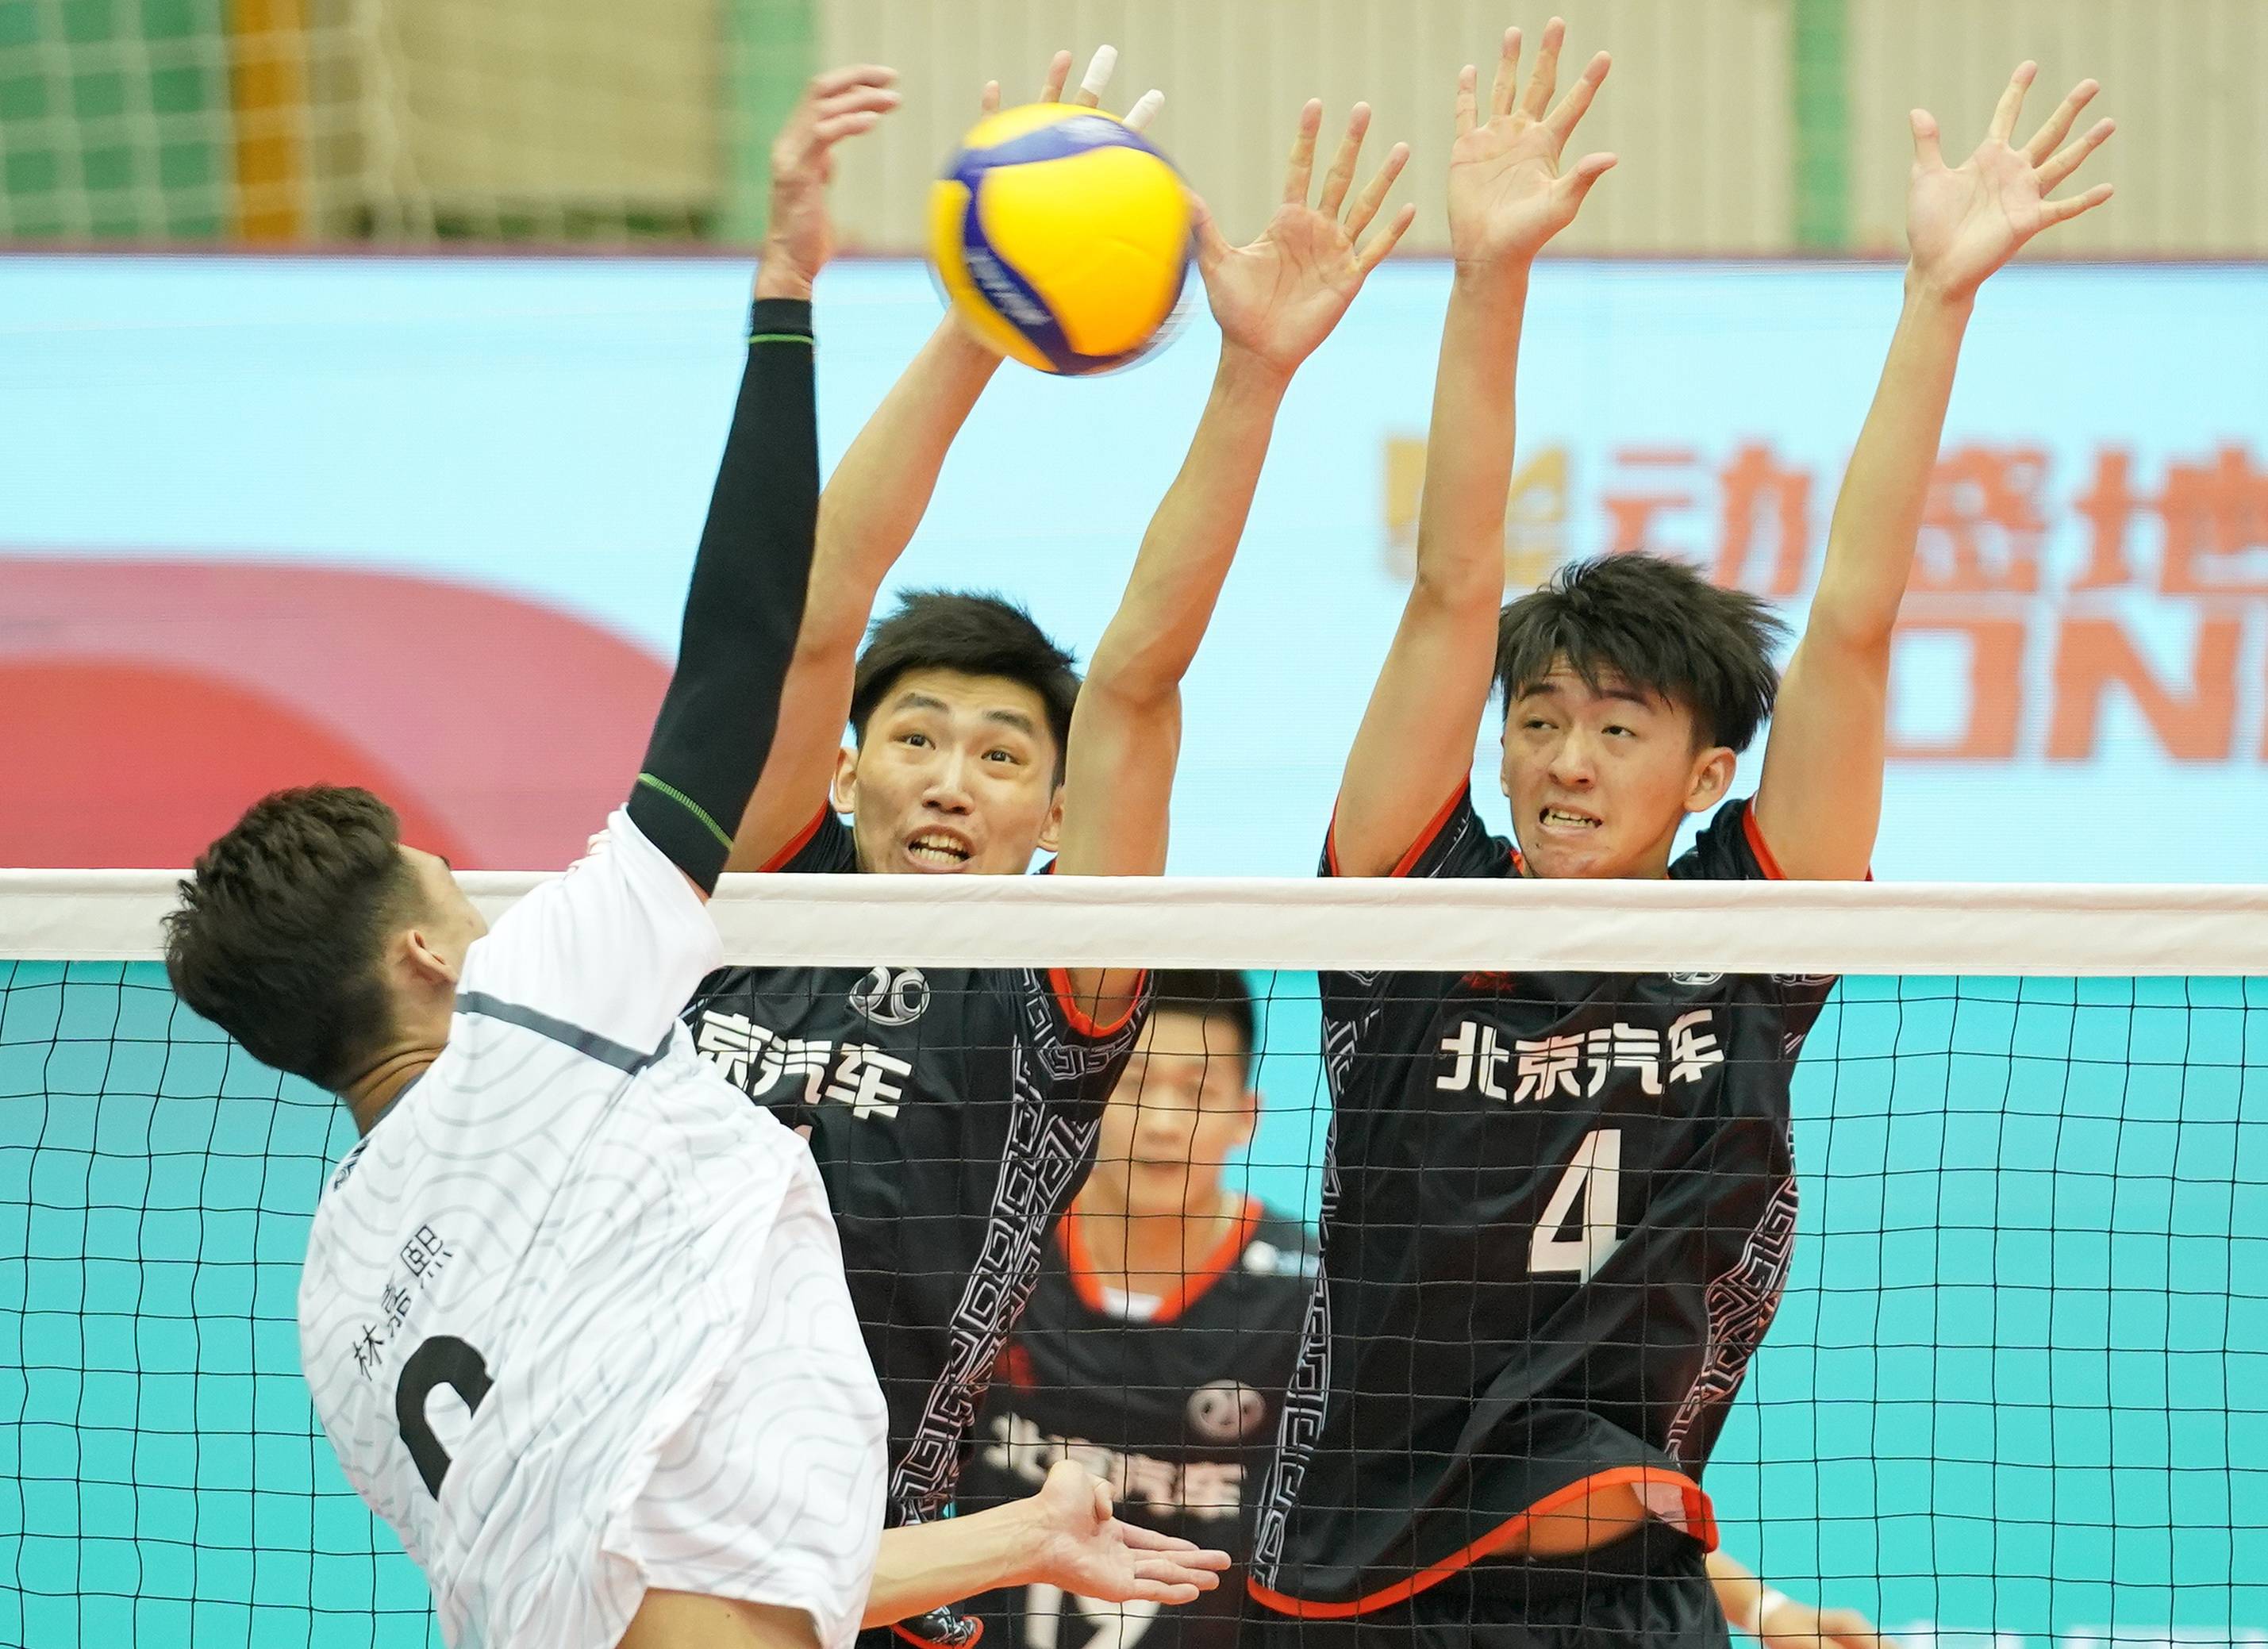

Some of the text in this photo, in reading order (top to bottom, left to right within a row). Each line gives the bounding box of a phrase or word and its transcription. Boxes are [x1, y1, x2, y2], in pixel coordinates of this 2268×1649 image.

[1884, 619, 2268, 759] ON
[1436, 1008, 1724, 1103] 北京汽车
[1527, 1128, 1622, 1287] 4
[352, 1224, 453, 1382] 林嘉熙
